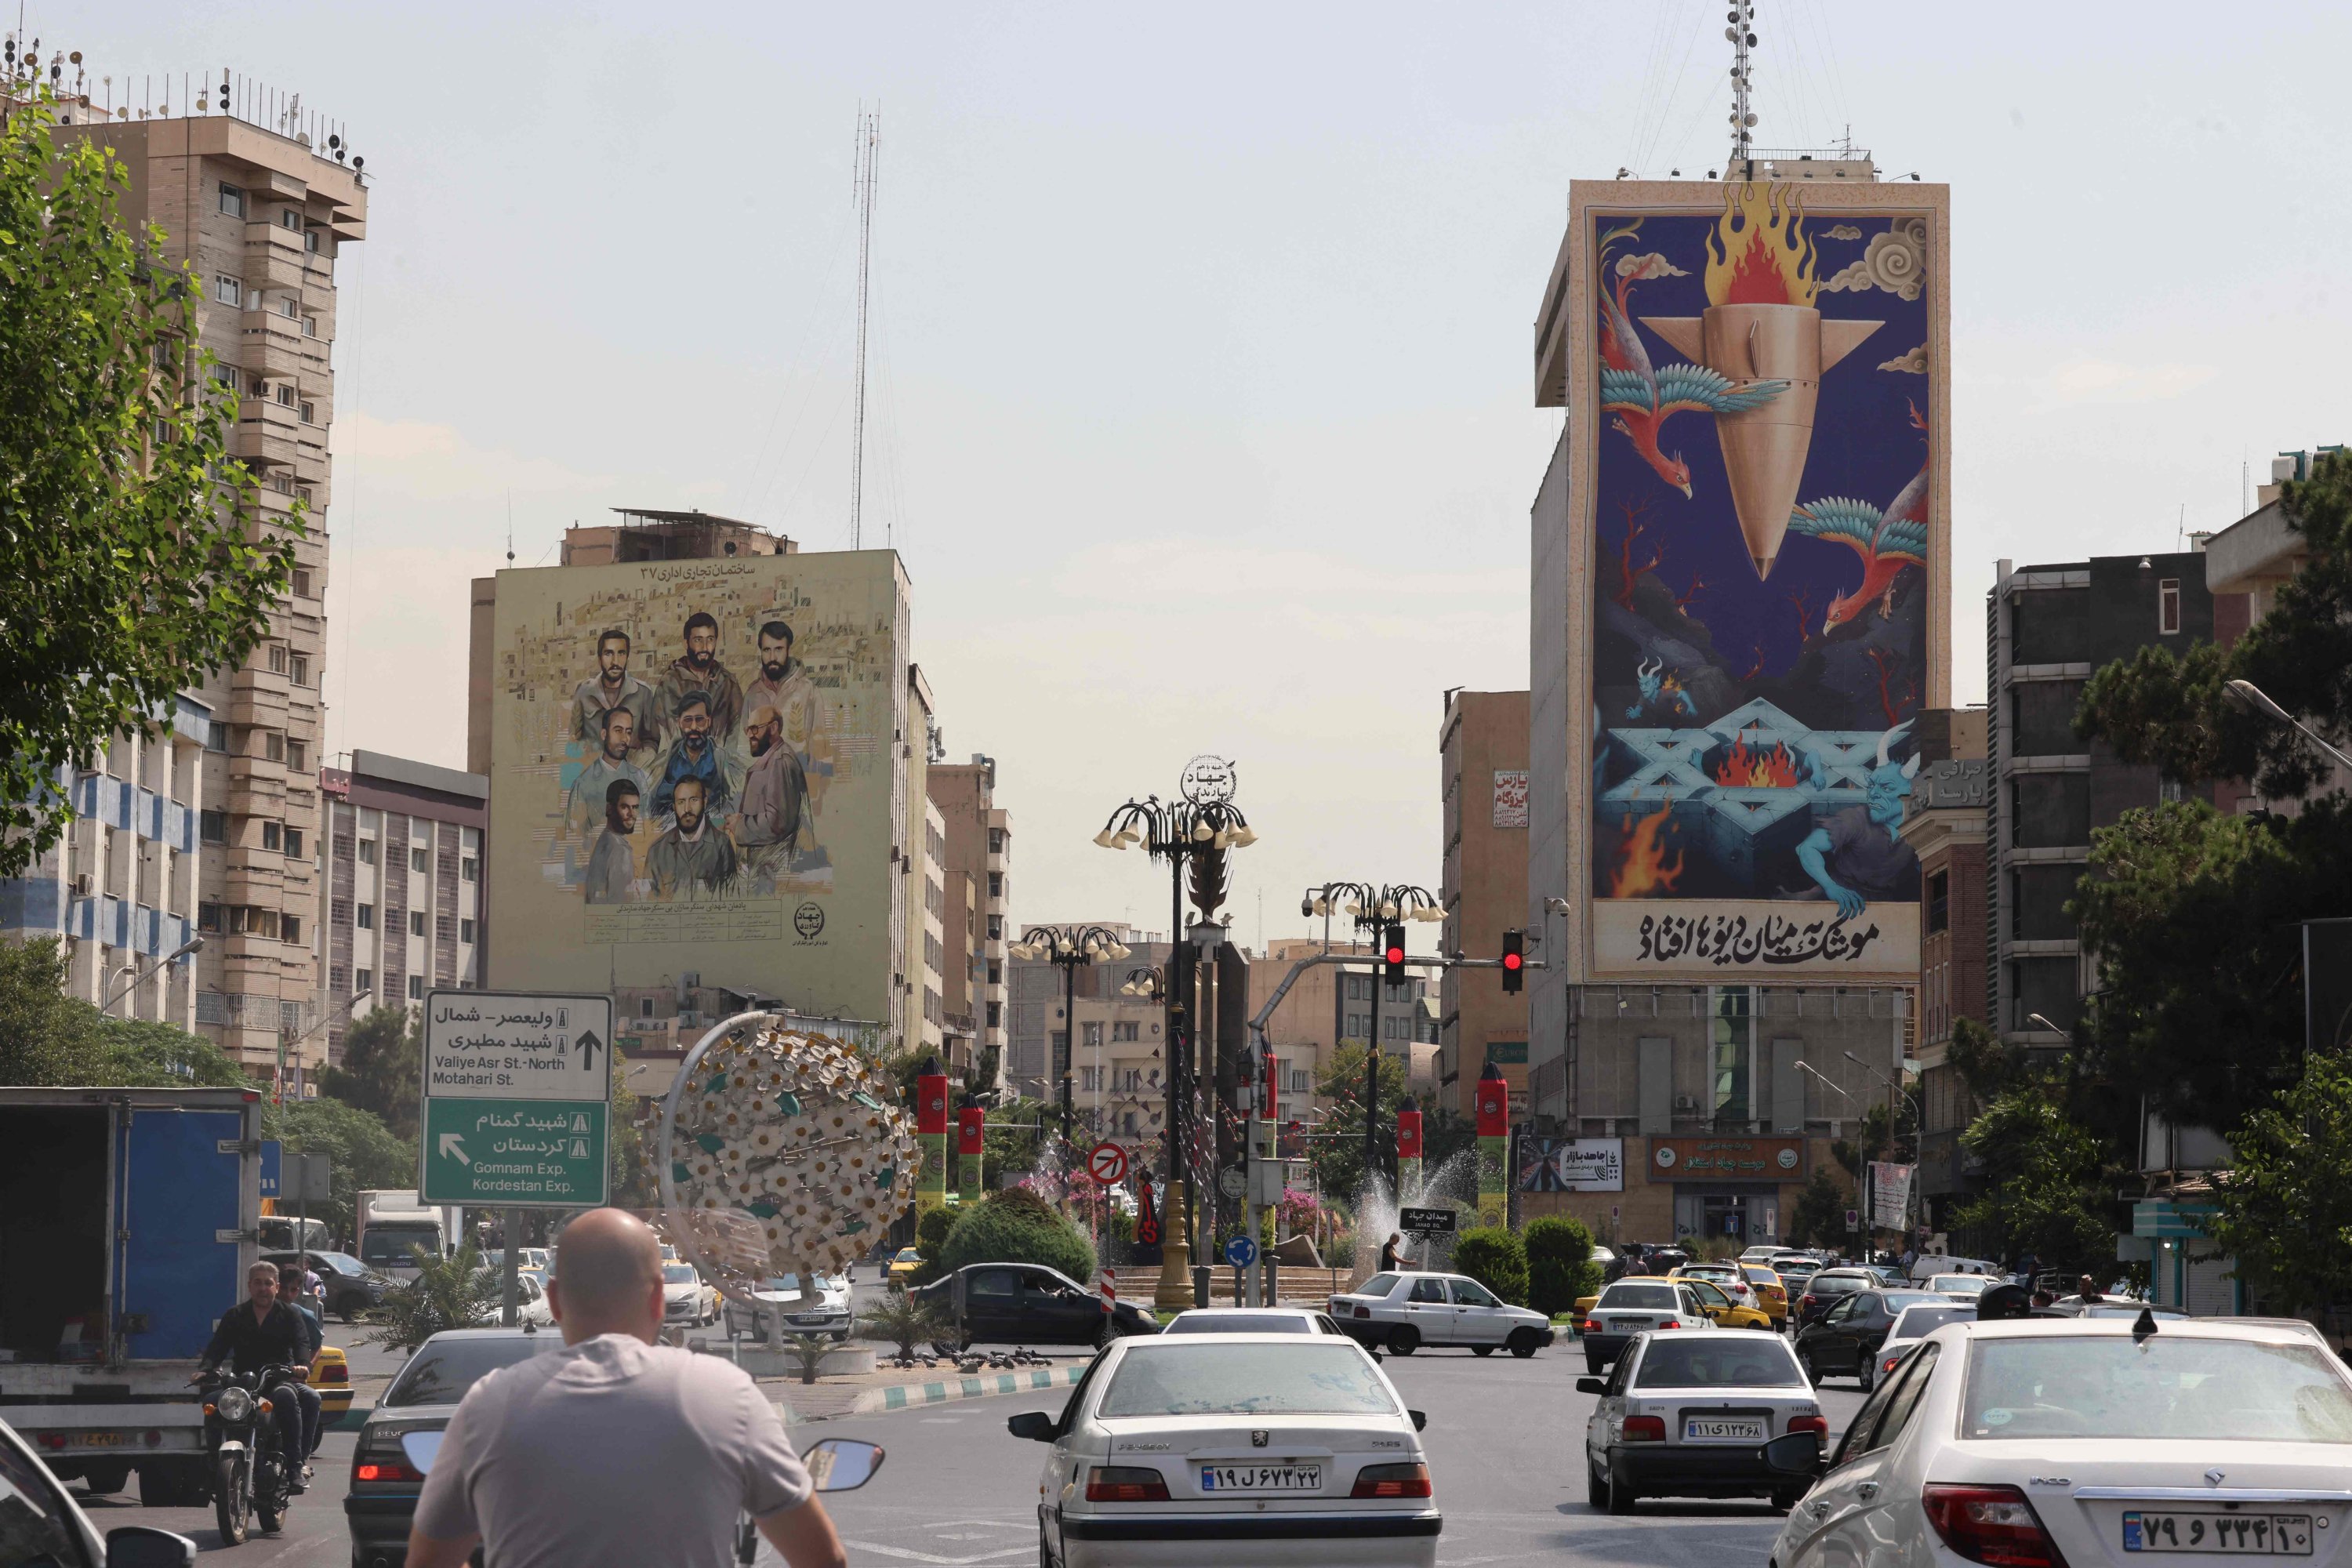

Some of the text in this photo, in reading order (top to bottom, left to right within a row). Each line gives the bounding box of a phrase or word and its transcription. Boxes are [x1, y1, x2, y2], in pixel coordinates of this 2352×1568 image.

[641, 563, 755, 582] ساختمان تجاری اداری ۳۷
[1187, 771, 1227, 786] جهاد
[1939, 760, 1982, 780] صرافی
[1496, 771, 1528, 789] پارس
[1189, 786, 1228, 799] سازندگی
[1495, 790, 1528, 808] ایزوگام
[1939, 783, 1982, 804] پارسه
[797, 913, 820, 922] جهاد
[435, 1007, 480, 1024] شمال
[495, 1011, 553, 1029] ولیعصر
[448, 1033, 552, 1051] شهید مطهری
[435, 1056, 475, 1070] Valiye
[477, 1057, 499, 1069] Asr
[433, 1072, 514, 1086] Motahari St.
[477, 1112, 567, 1132] شهید گمنام
[493, 1138, 567, 1157] کردستان
[1566, 1151, 1605, 1163] جاهد بازار
[1683, 1156, 1766, 1172] موسسه جهاد استقلال
[474, 1161, 566, 1178] Gomnam Exp.
[473, 1179, 574, 1194] Kordestan Exp.
[1408, 1210, 1448, 1222] میدان جهاد
[1118, 1442, 1171, 1450] PEUGEOT
[1297, 1472, 1318, 1487] ۲۲
[2278, 1526, 2307, 1552] ۱۰
